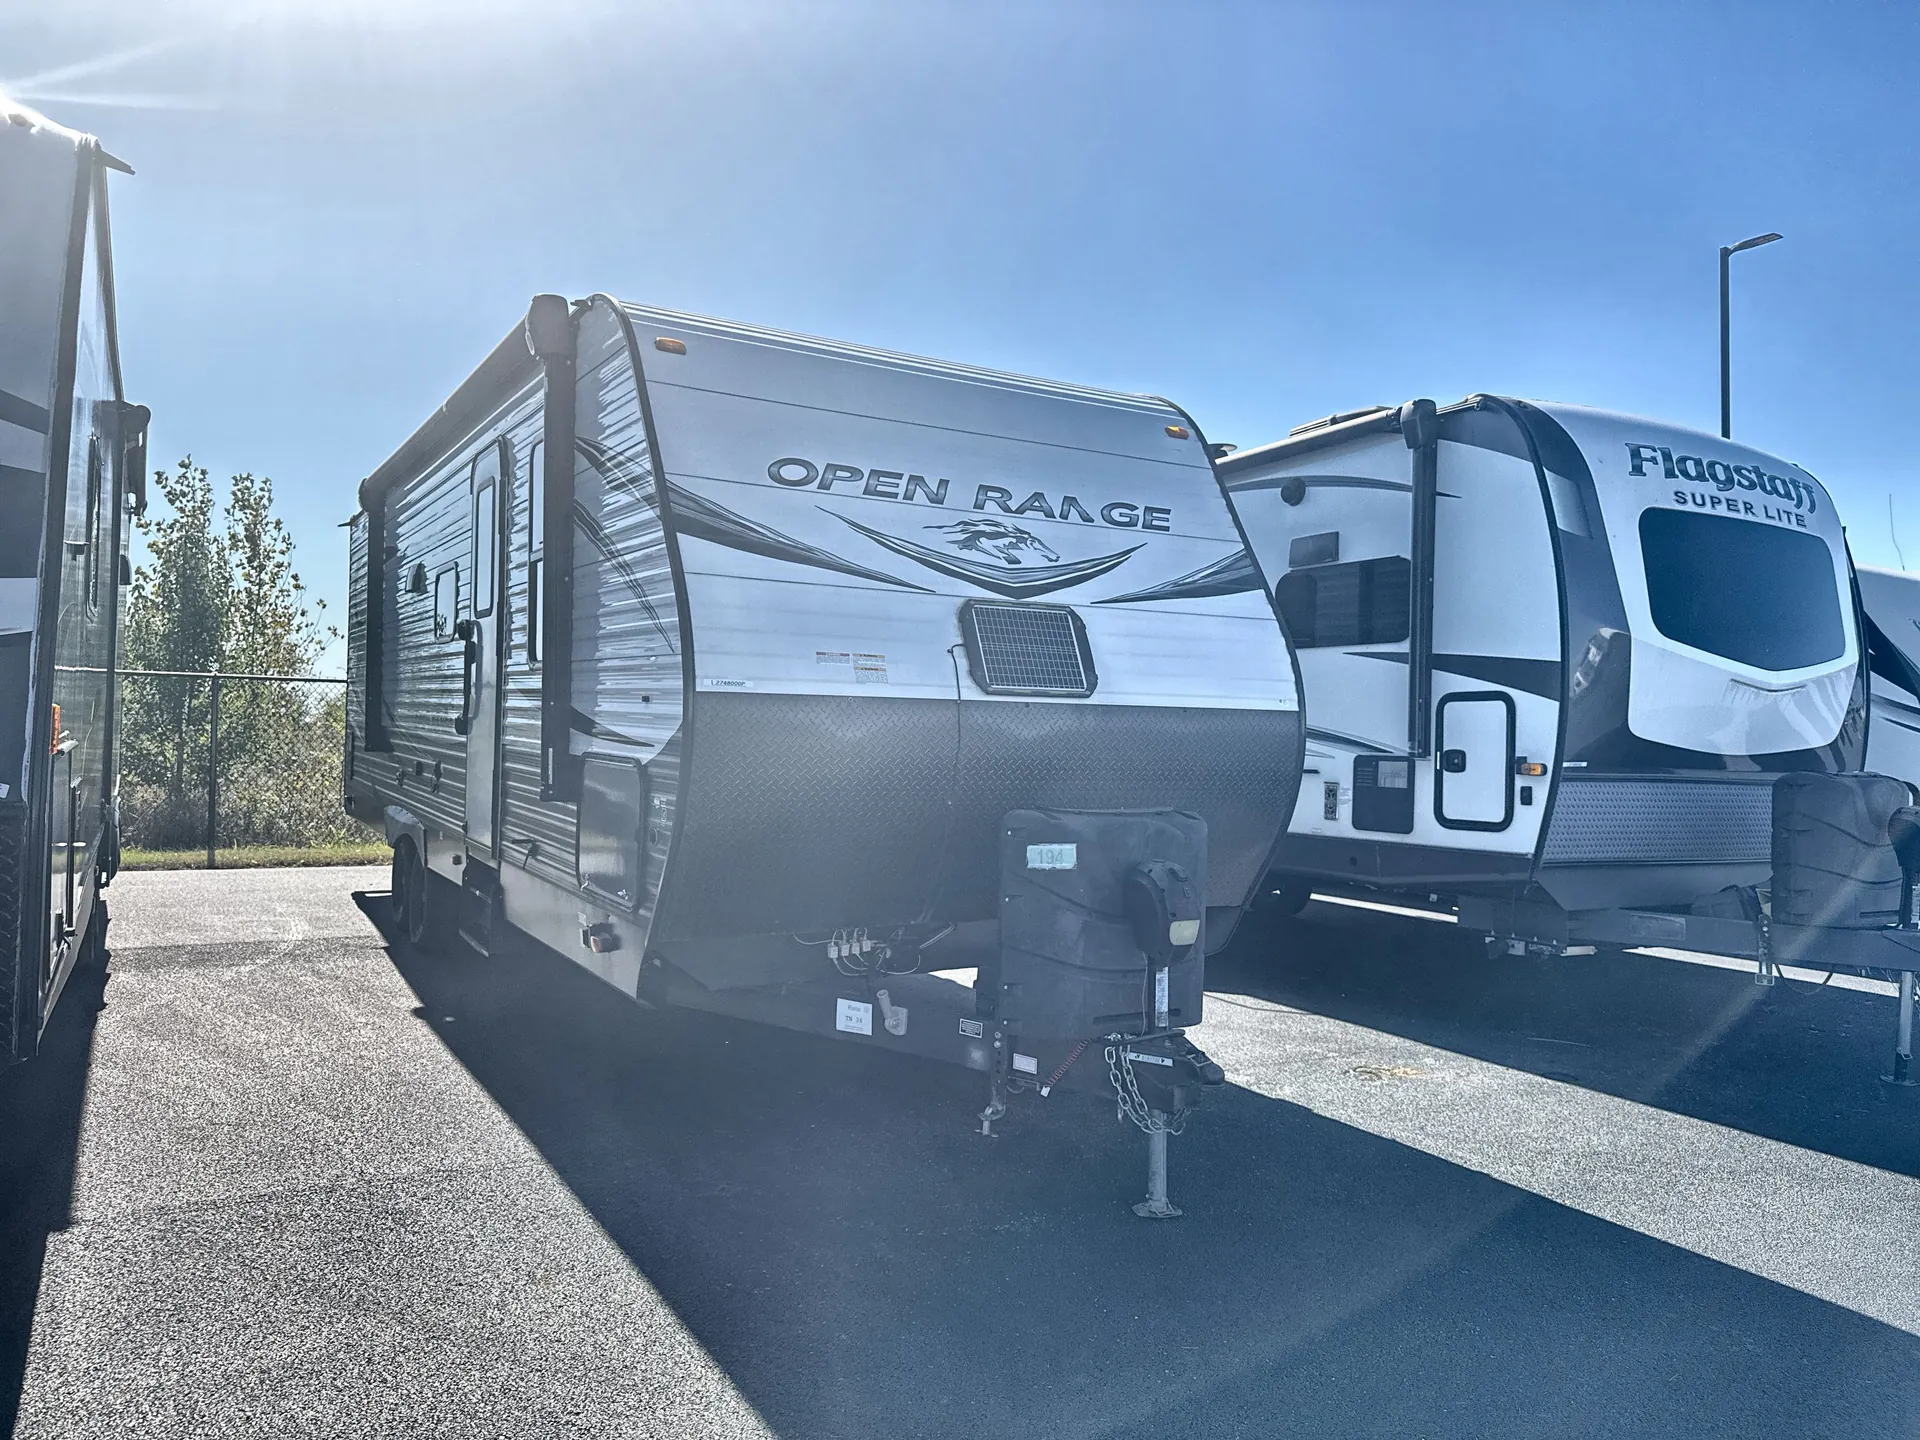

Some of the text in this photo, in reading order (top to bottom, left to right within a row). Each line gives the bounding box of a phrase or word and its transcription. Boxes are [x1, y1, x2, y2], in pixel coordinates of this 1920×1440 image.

[767, 457, 1172, 532] OPEN RANGE
[1624, 442, 1816, 514] Flagstaff
[1674, 490, 1808, 529] SUPER LITE
[1037, 848, 1065, 865] 194
